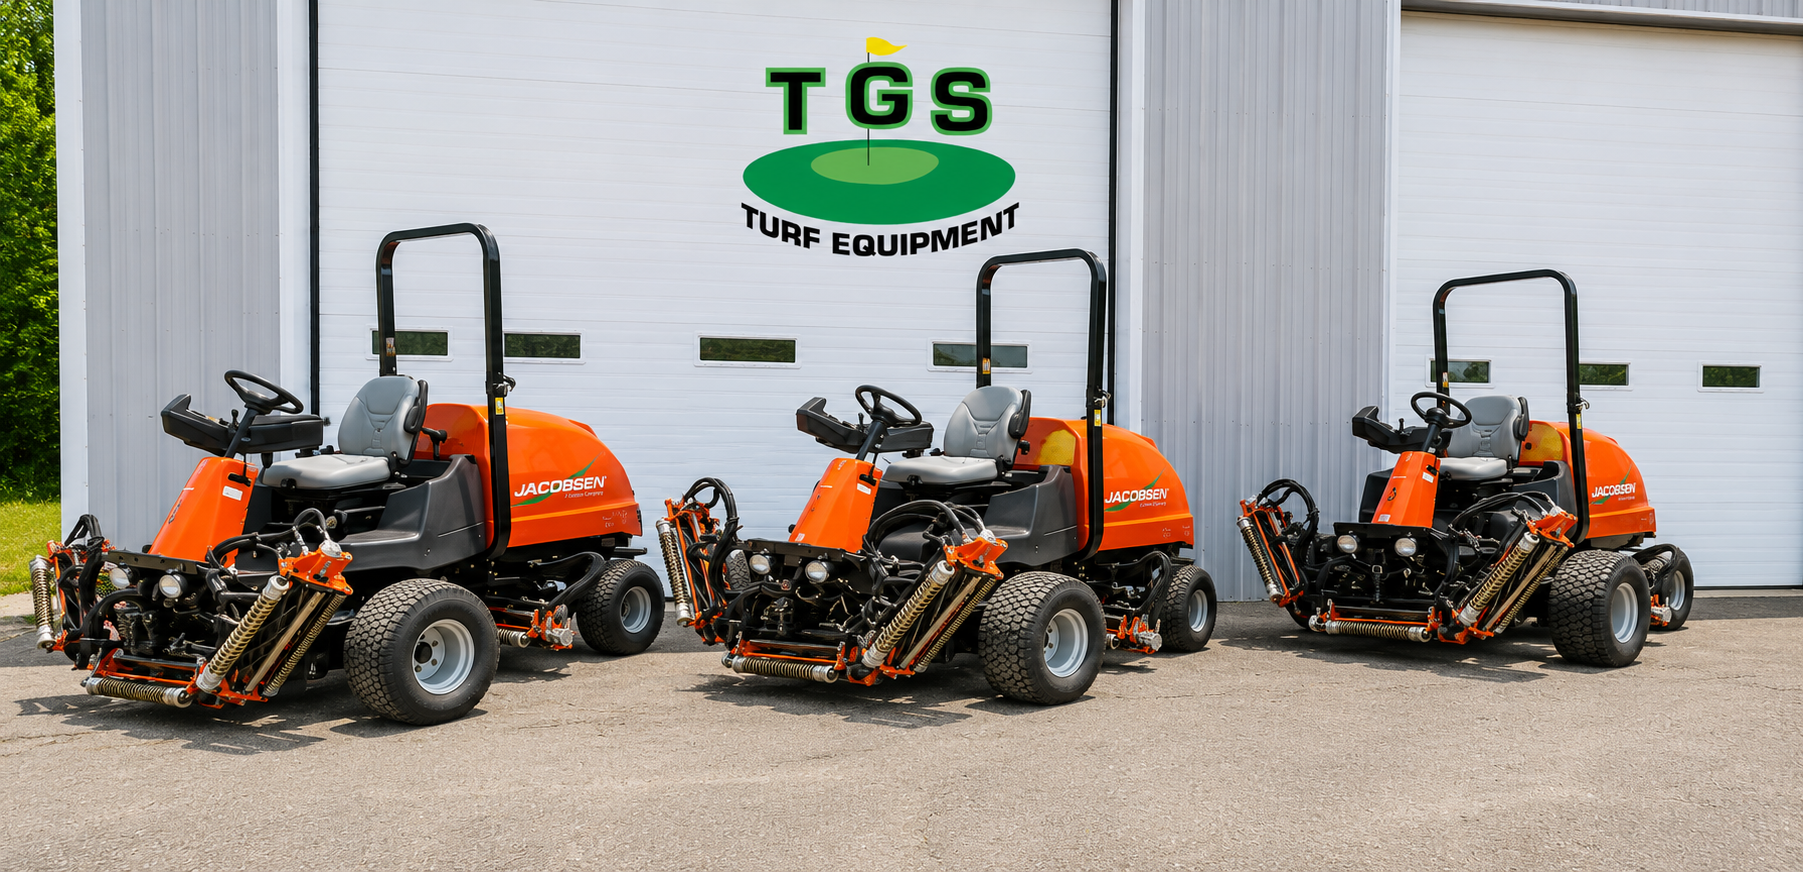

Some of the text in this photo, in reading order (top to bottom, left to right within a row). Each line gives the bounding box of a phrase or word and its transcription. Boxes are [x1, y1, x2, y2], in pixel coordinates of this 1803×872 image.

[741, 202, 1019, 257] TURF EQUIPMENT
[514, 476, 605, 497] JACOBSEN
[1592, 482, 1636, 498] JACOBSEN
[1105, 488, 1168, 504] JACOBSEN
